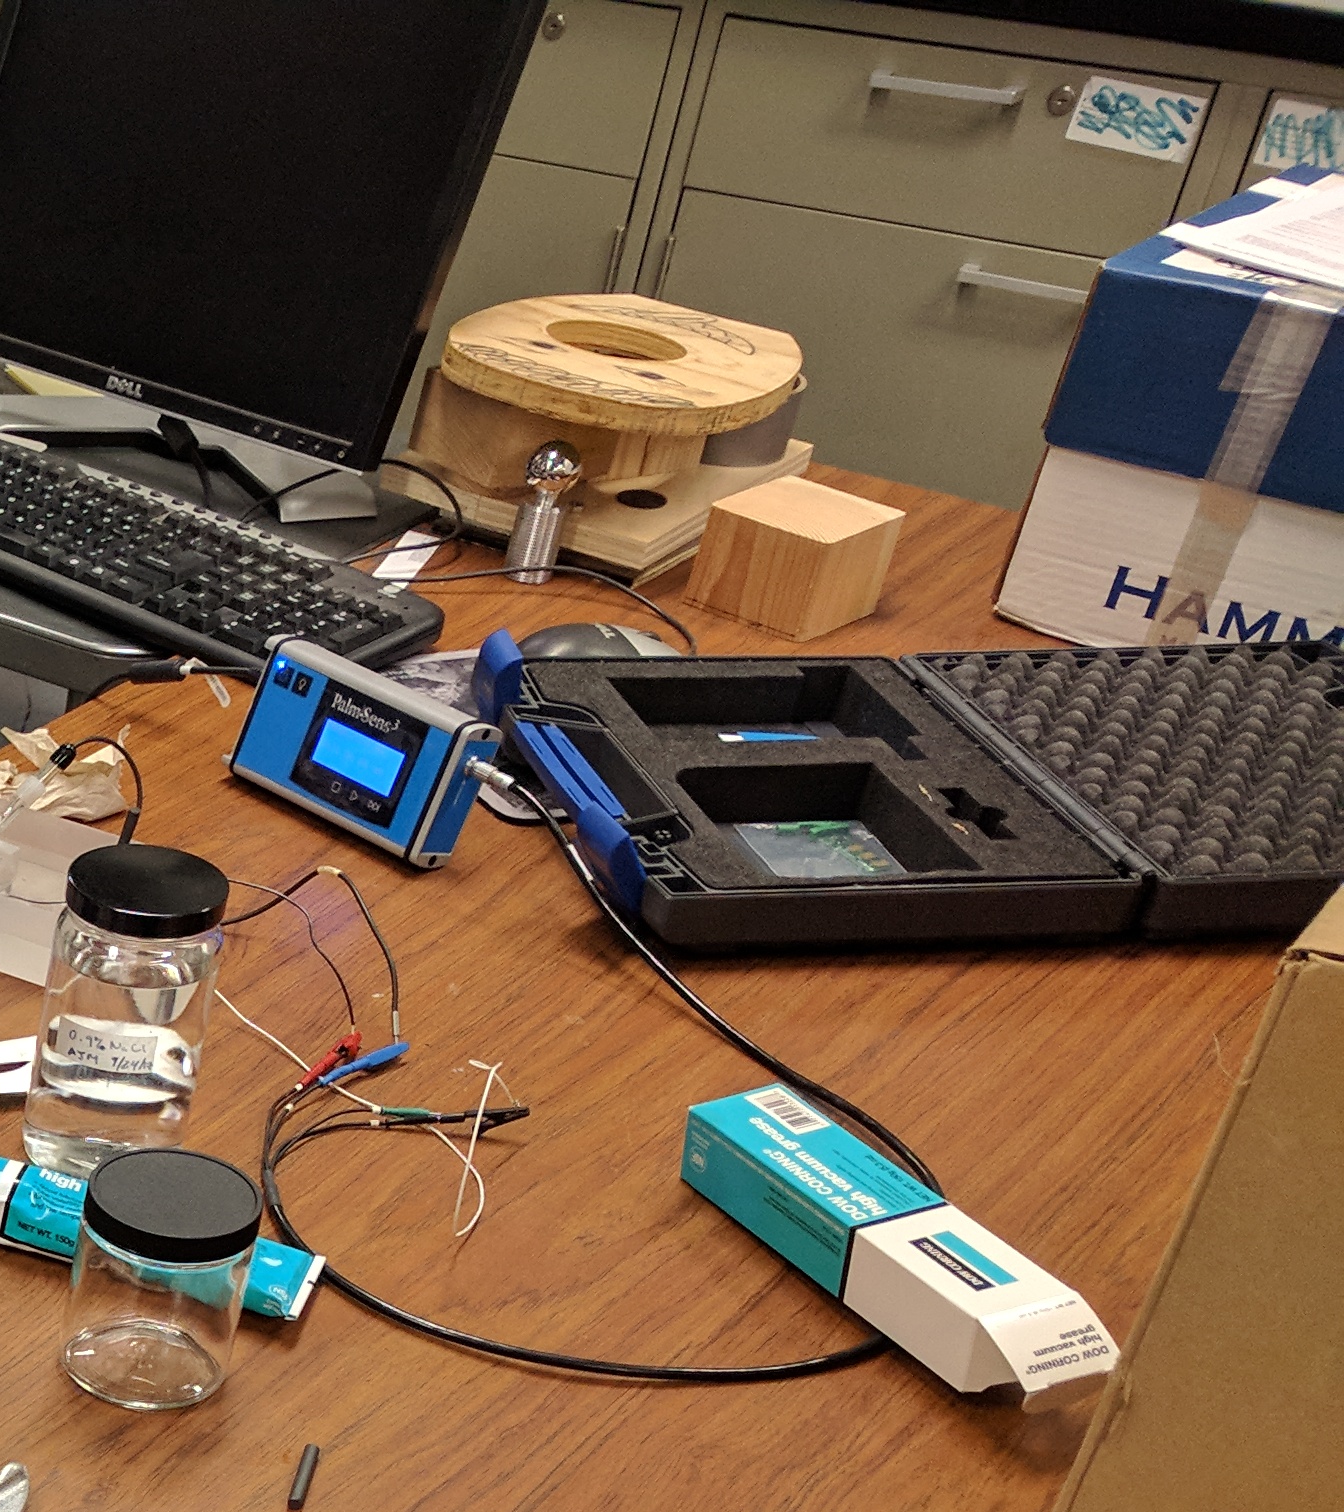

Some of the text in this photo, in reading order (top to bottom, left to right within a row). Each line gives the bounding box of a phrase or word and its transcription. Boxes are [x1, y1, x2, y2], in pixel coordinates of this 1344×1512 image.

[105, 375, 144, 398] DELL
[748, 1116, 799, 1150] grease
[39, 1168, 82, 1192] high
[796, 1150, 855, 1192] vacuum
[827, 1189, 869, 1221] DOW
[851, 1189, 889, 1218] high
[18, 1220, 76, 1248] NET WT. 150g
[919, 1240, 984, 1287] DOW CORNING
[1032, 1333, 1102, 1358] high vacuum
[1059, 1324, 1096, 1340] grease
[1082, 1345, 1110, 1362] DOW
